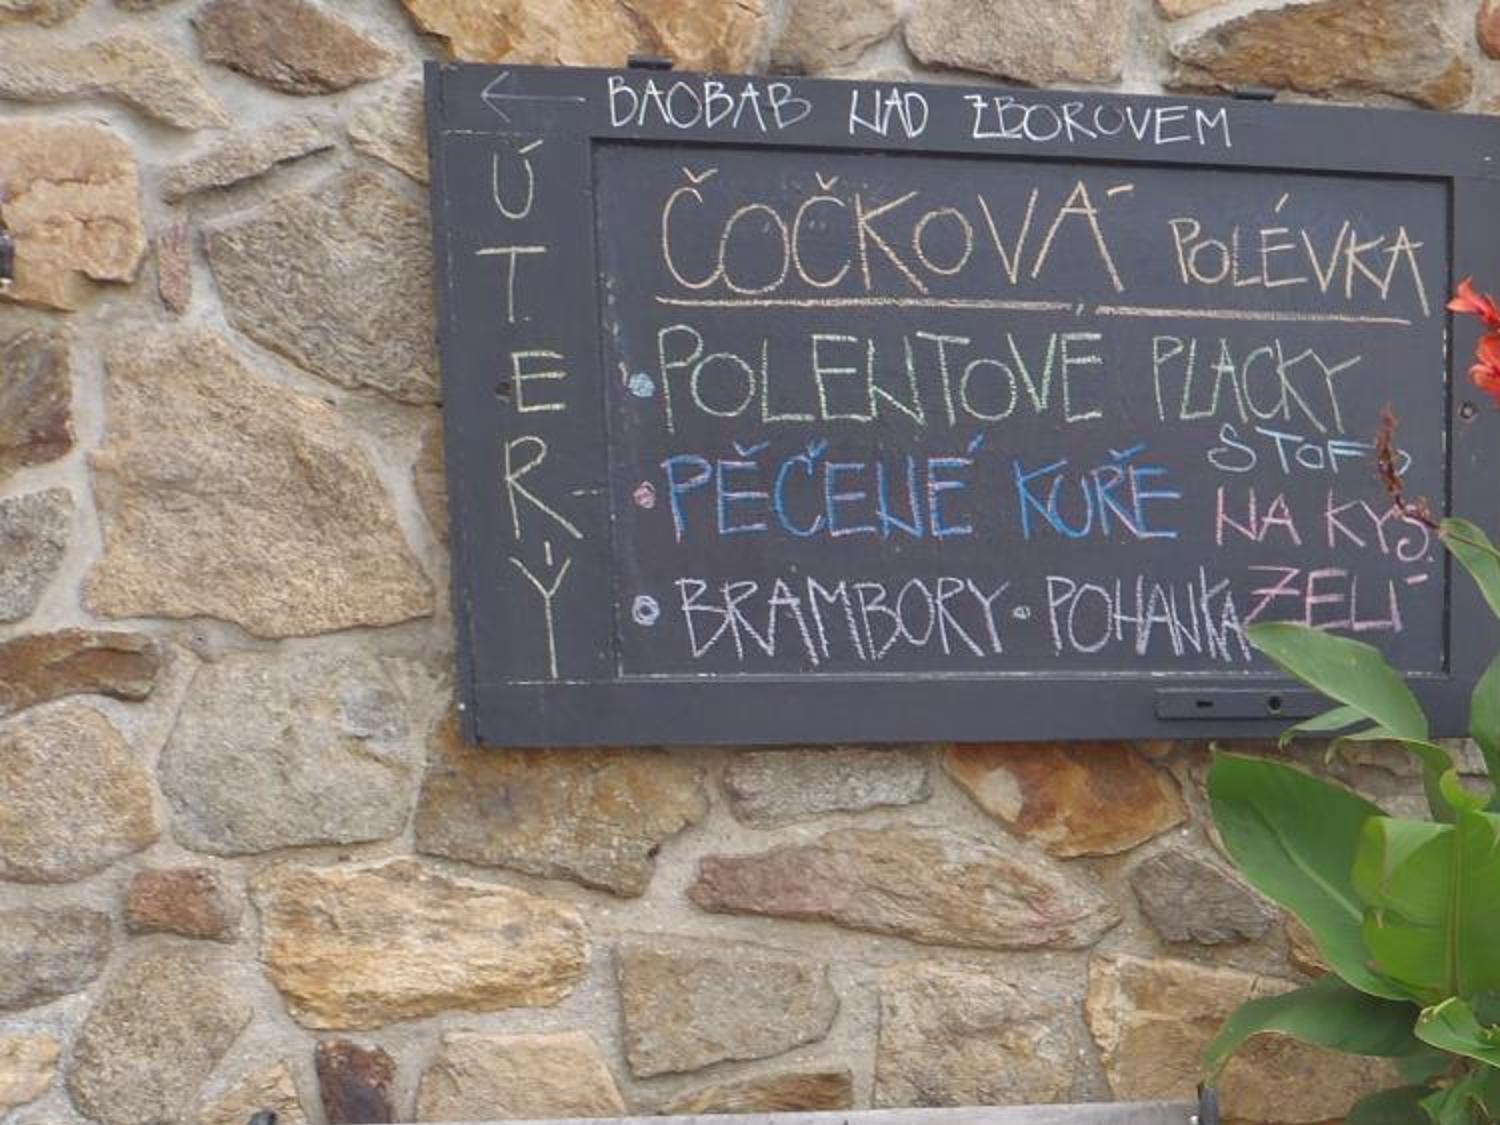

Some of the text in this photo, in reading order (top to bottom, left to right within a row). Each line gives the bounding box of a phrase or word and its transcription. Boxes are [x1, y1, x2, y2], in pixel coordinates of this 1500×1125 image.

[606, 74, 1232, 148] BAOBAB NAD ZBOROVEM
[661, 165, 1431, 318] ČOČKOVÁ POLÉVKA
[475, 138, 584, 680] ÚTERÝ
[657, 302, 1362, 435] POLENTOVÉ PLACKY
[1012, 443, 1182, 540] KUŘE
[1215, 485, 1303, 546] NA
[674, 565, 1253, 665] BRAMBORY POHANKA
[1242, 564, 1430, 633] ZELÍ
